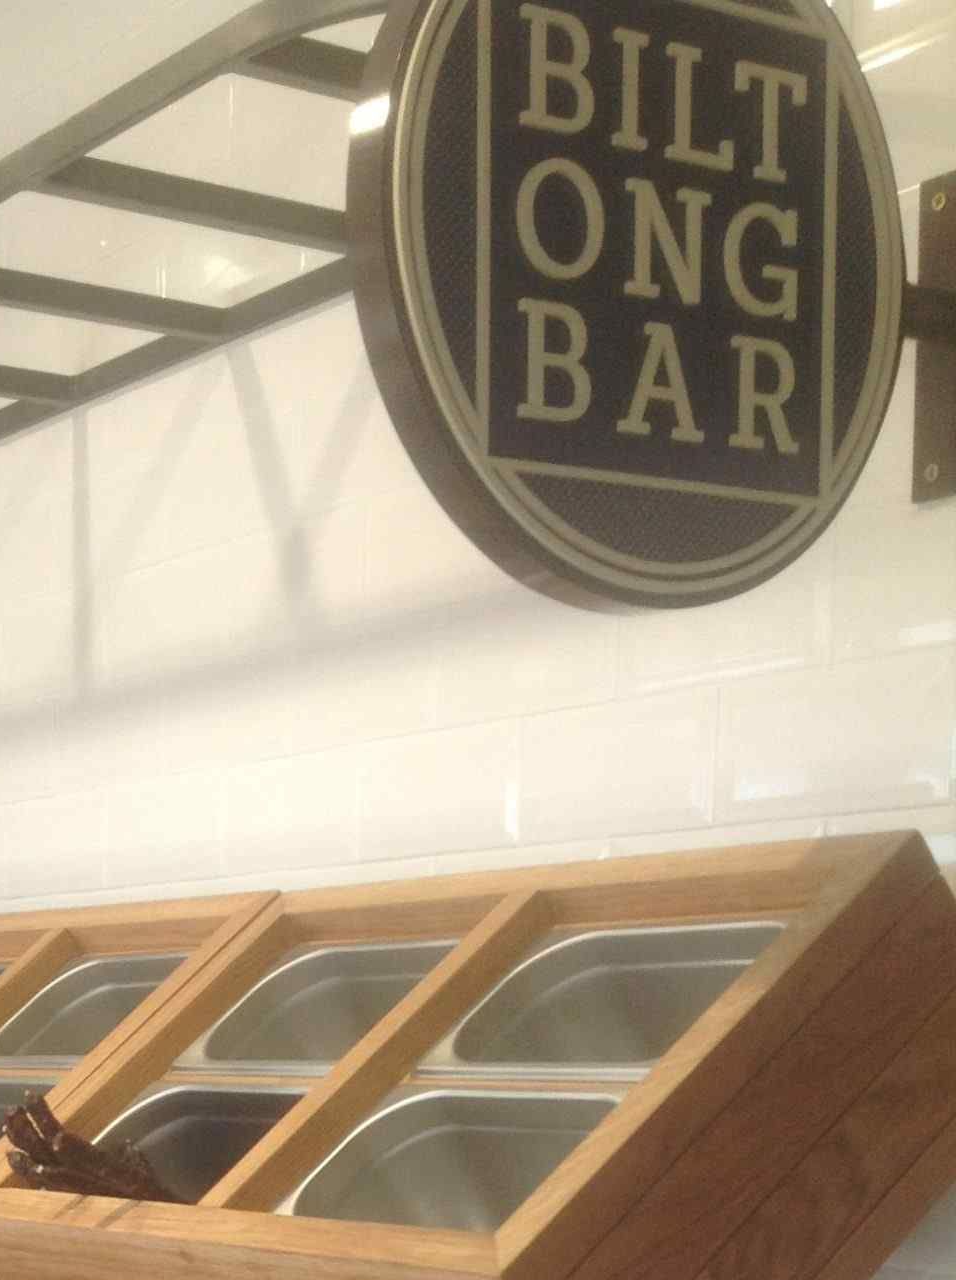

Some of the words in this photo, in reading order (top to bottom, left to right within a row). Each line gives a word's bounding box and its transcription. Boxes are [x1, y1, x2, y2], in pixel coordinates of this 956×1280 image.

[518, 4, 808, 184] BILT
[517, 157, 800, 321] ONG
[516, 298, 800, 454] BAR
